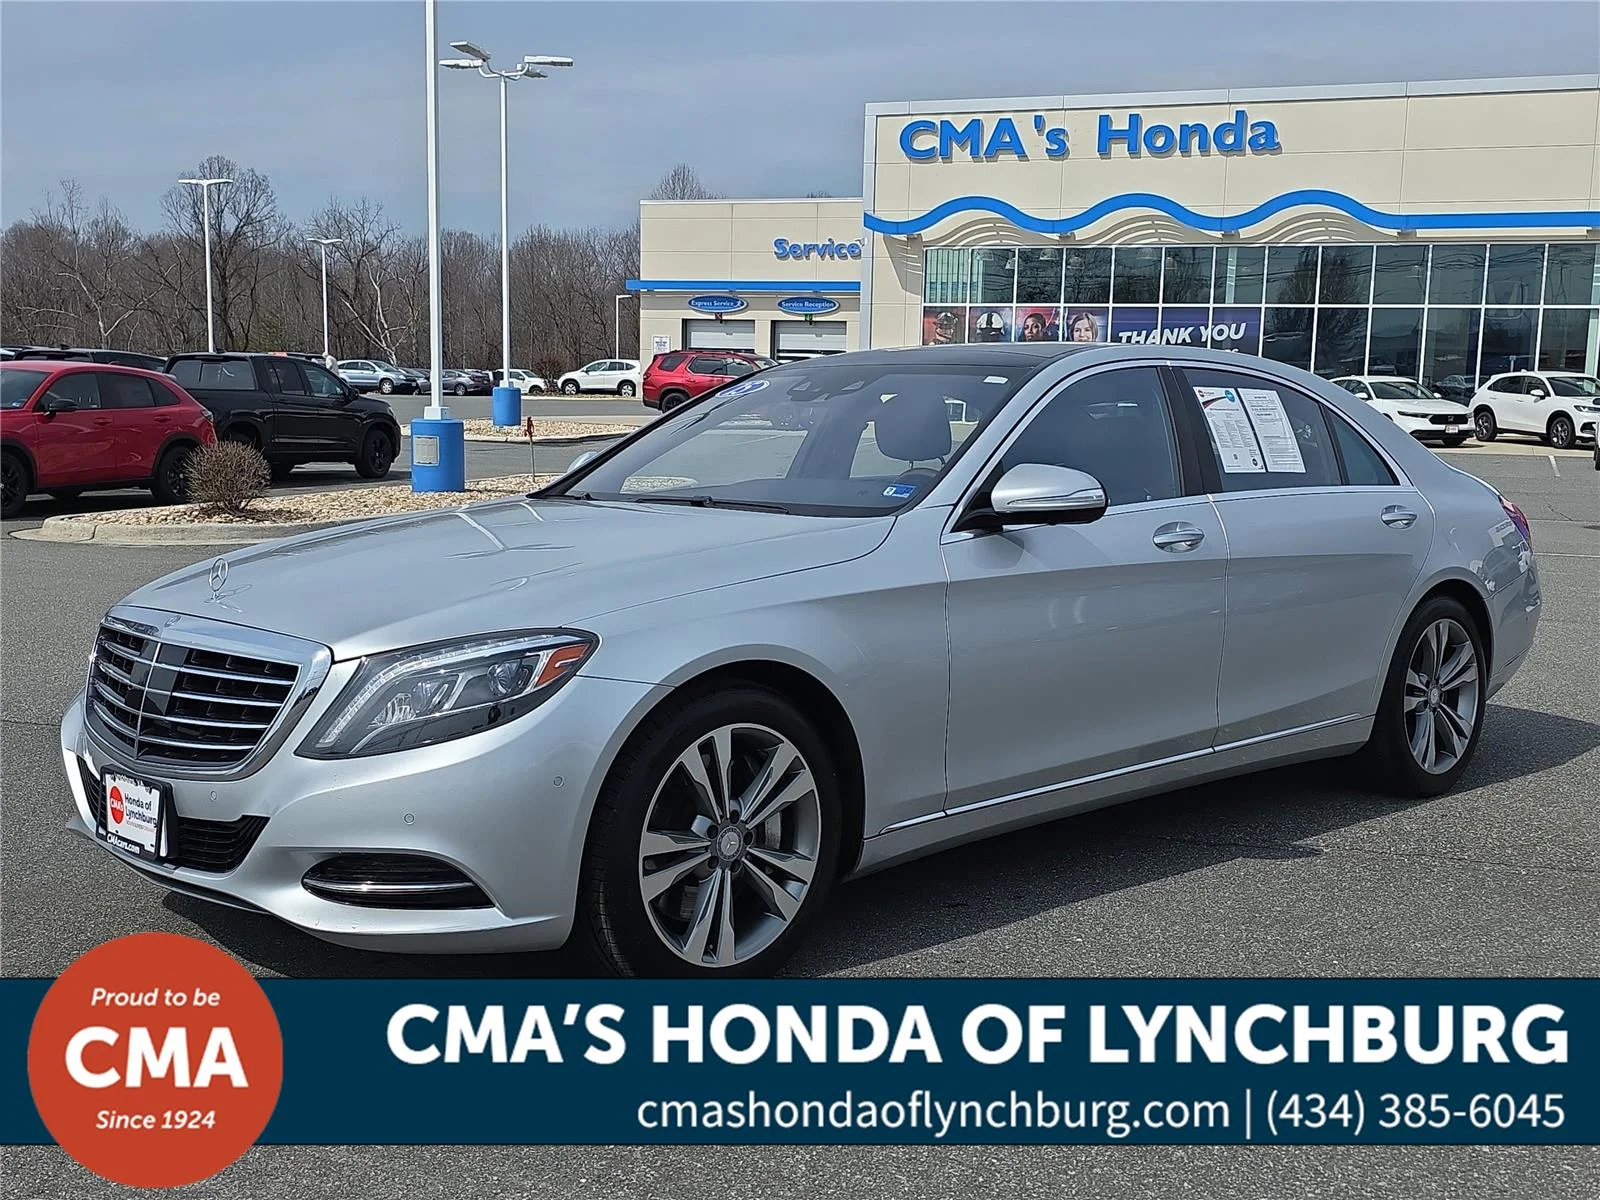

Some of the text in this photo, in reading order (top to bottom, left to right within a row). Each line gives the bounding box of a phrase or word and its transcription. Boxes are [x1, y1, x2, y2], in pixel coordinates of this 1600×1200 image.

[900, 110, 1281, 161] CMA's Honda
[773, 238, 862, 260] Service
[1118, 322, 1247, 345] THANK YOU
[125, 793, 152, 811] Honda of
[125, 806, 157, 828] Lynchburg
